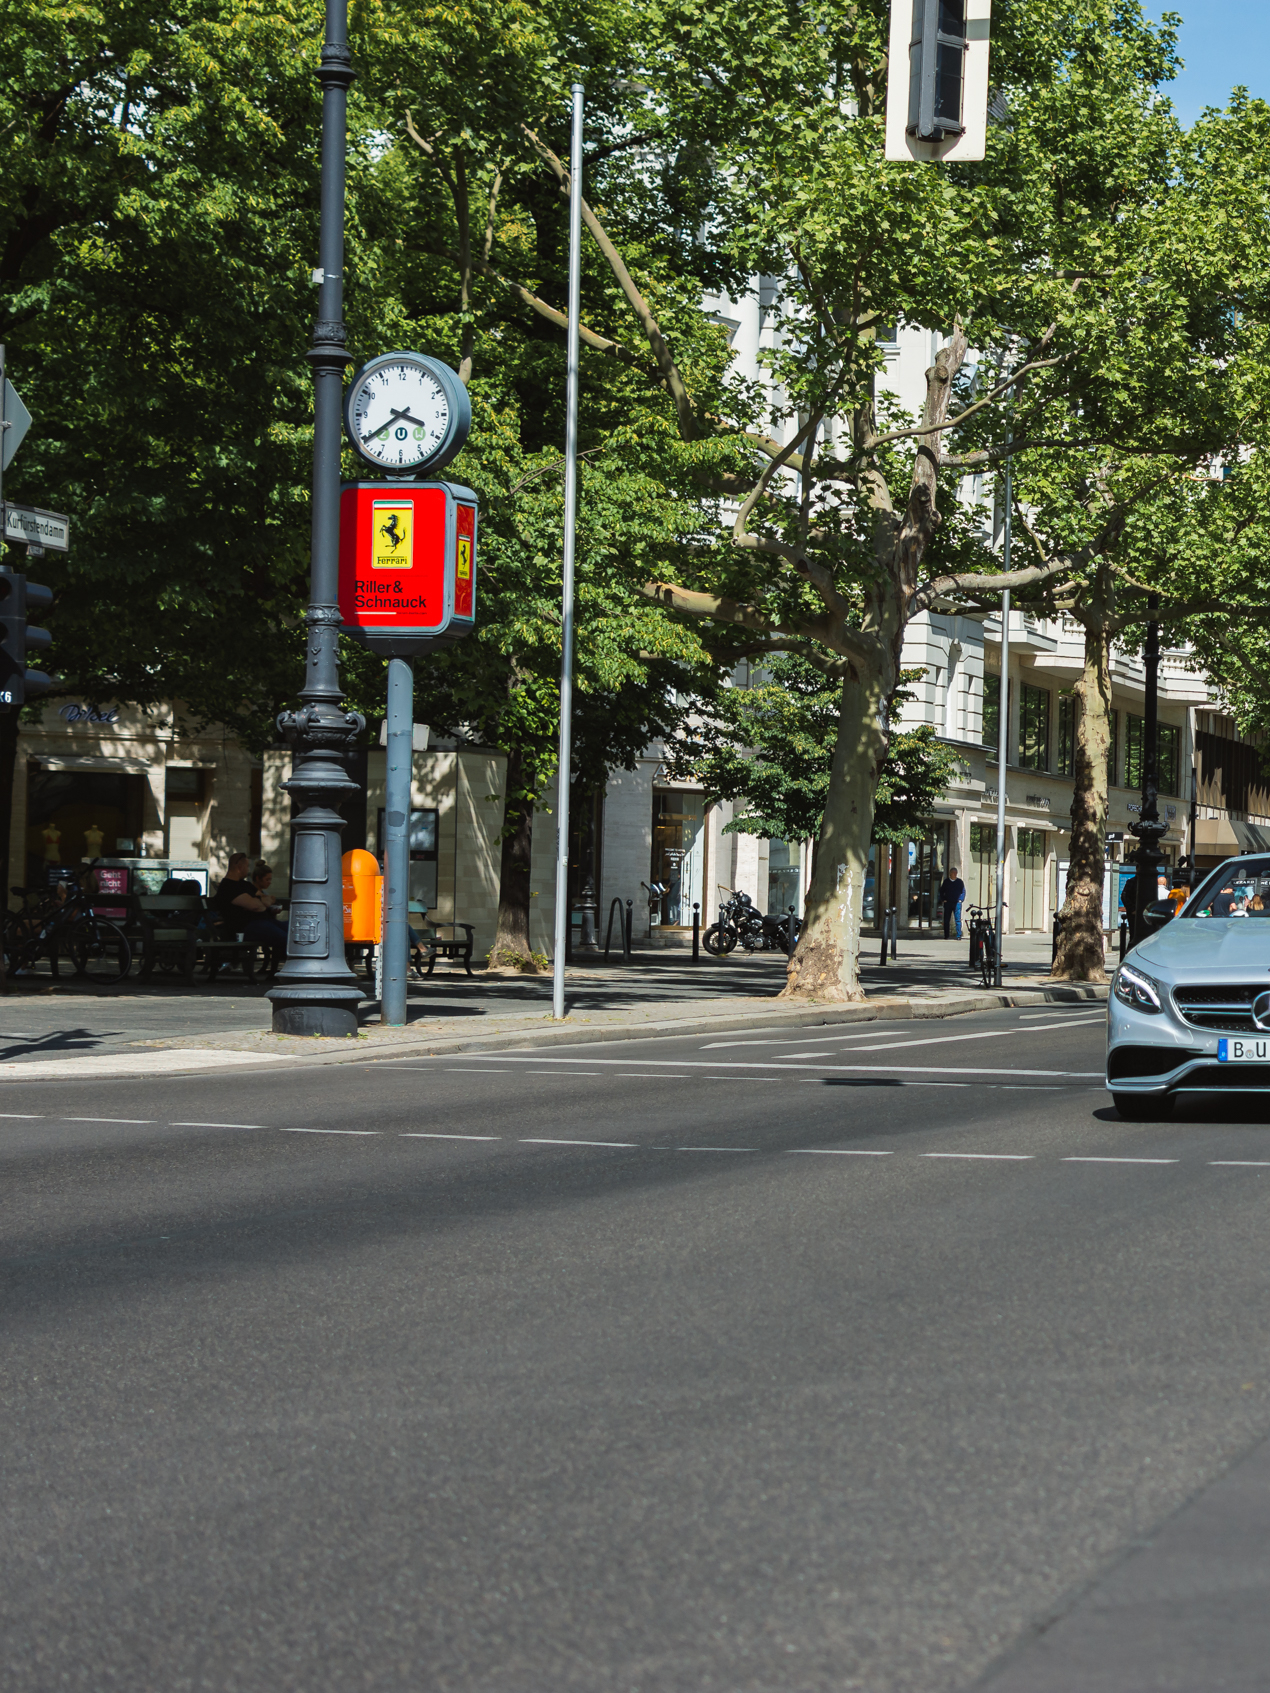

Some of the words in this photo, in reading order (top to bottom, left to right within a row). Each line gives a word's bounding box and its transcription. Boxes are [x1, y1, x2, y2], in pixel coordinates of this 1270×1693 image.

[398, 373, 407, 381] 12
[382, 378, 389, 386] 11
[418, 378, 422, 386] 1
[367, 392, 376, 400] 10
[431, 392, 436, 400] 2
[363, 411, 368, 419] 9
[381, 444, 386, 452] 7
[398, 449, 403, 457] 6
[7, 511, 64, 539] Kurfürstendamm
[377, 556, 408, 564] Ferrari
[355, 580, 391, 593] Riller
[393, 580, 403, 593] &
[355, 595, 427, 608] Schnauck
[100, 870, 121, 878] Geht
[1234, 1042, 1244, 1058] B
[1256, 1042, 1266, 1058] U
